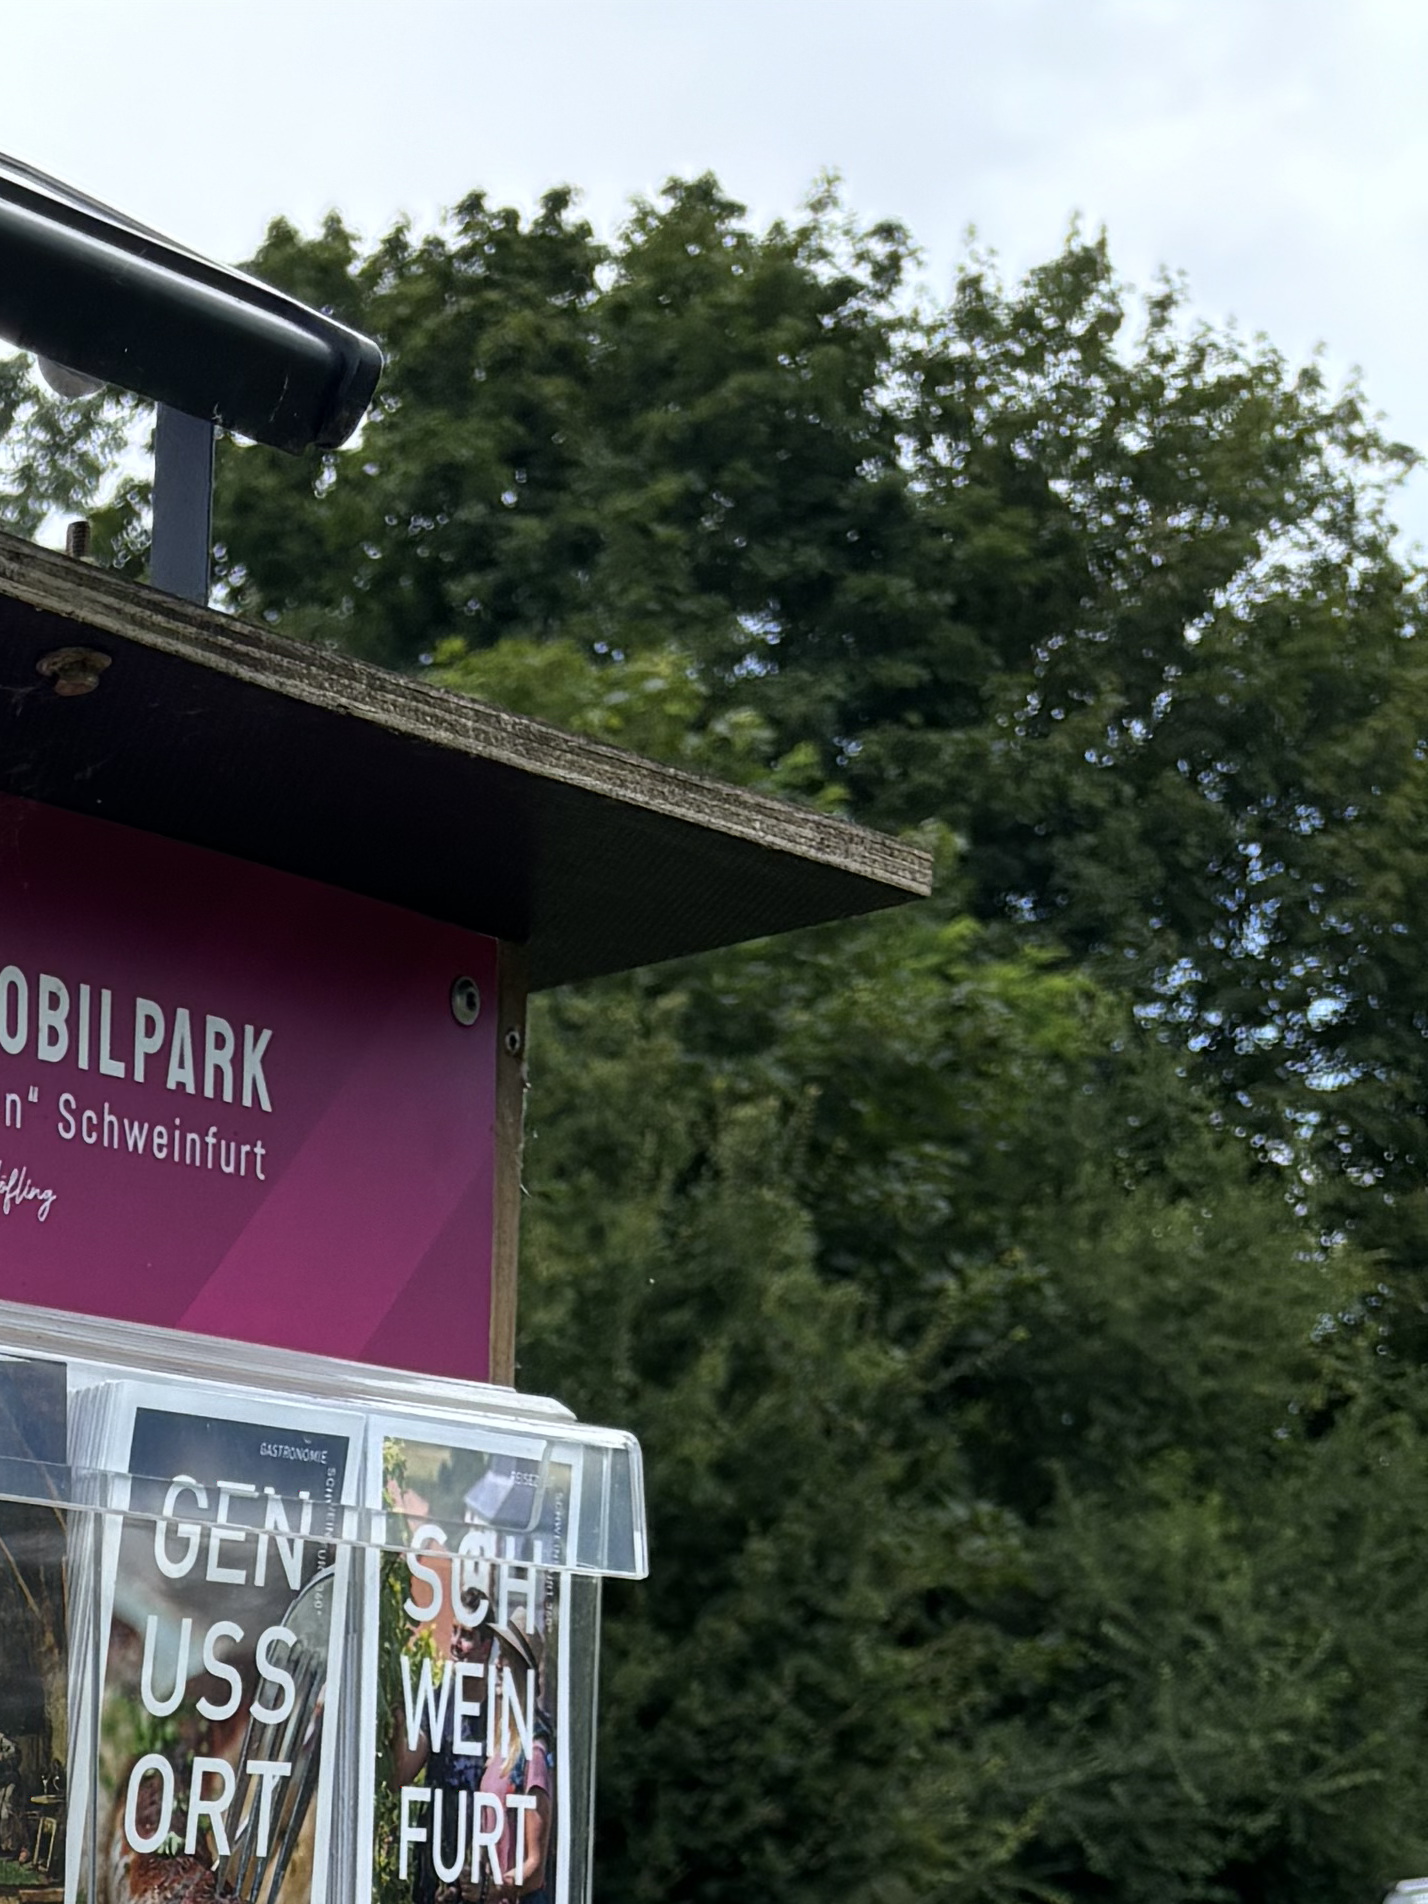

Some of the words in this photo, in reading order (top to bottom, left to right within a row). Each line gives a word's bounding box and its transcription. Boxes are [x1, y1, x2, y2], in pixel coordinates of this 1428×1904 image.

[56, 1092, 268, 1180] Schweinfurt
[260, 1442, 328, 1465] GASTRONOMIE
[154, 1474, 313, 1592] GEN
[403, 1524, 543, 1635] SCH
[140, 1614, 298, 1725] USS
[400, 1654, 536, 1762] WEIN
[124, 1753, 293, 1858] ORT
[399, 1786, 537, 1886] FURT
